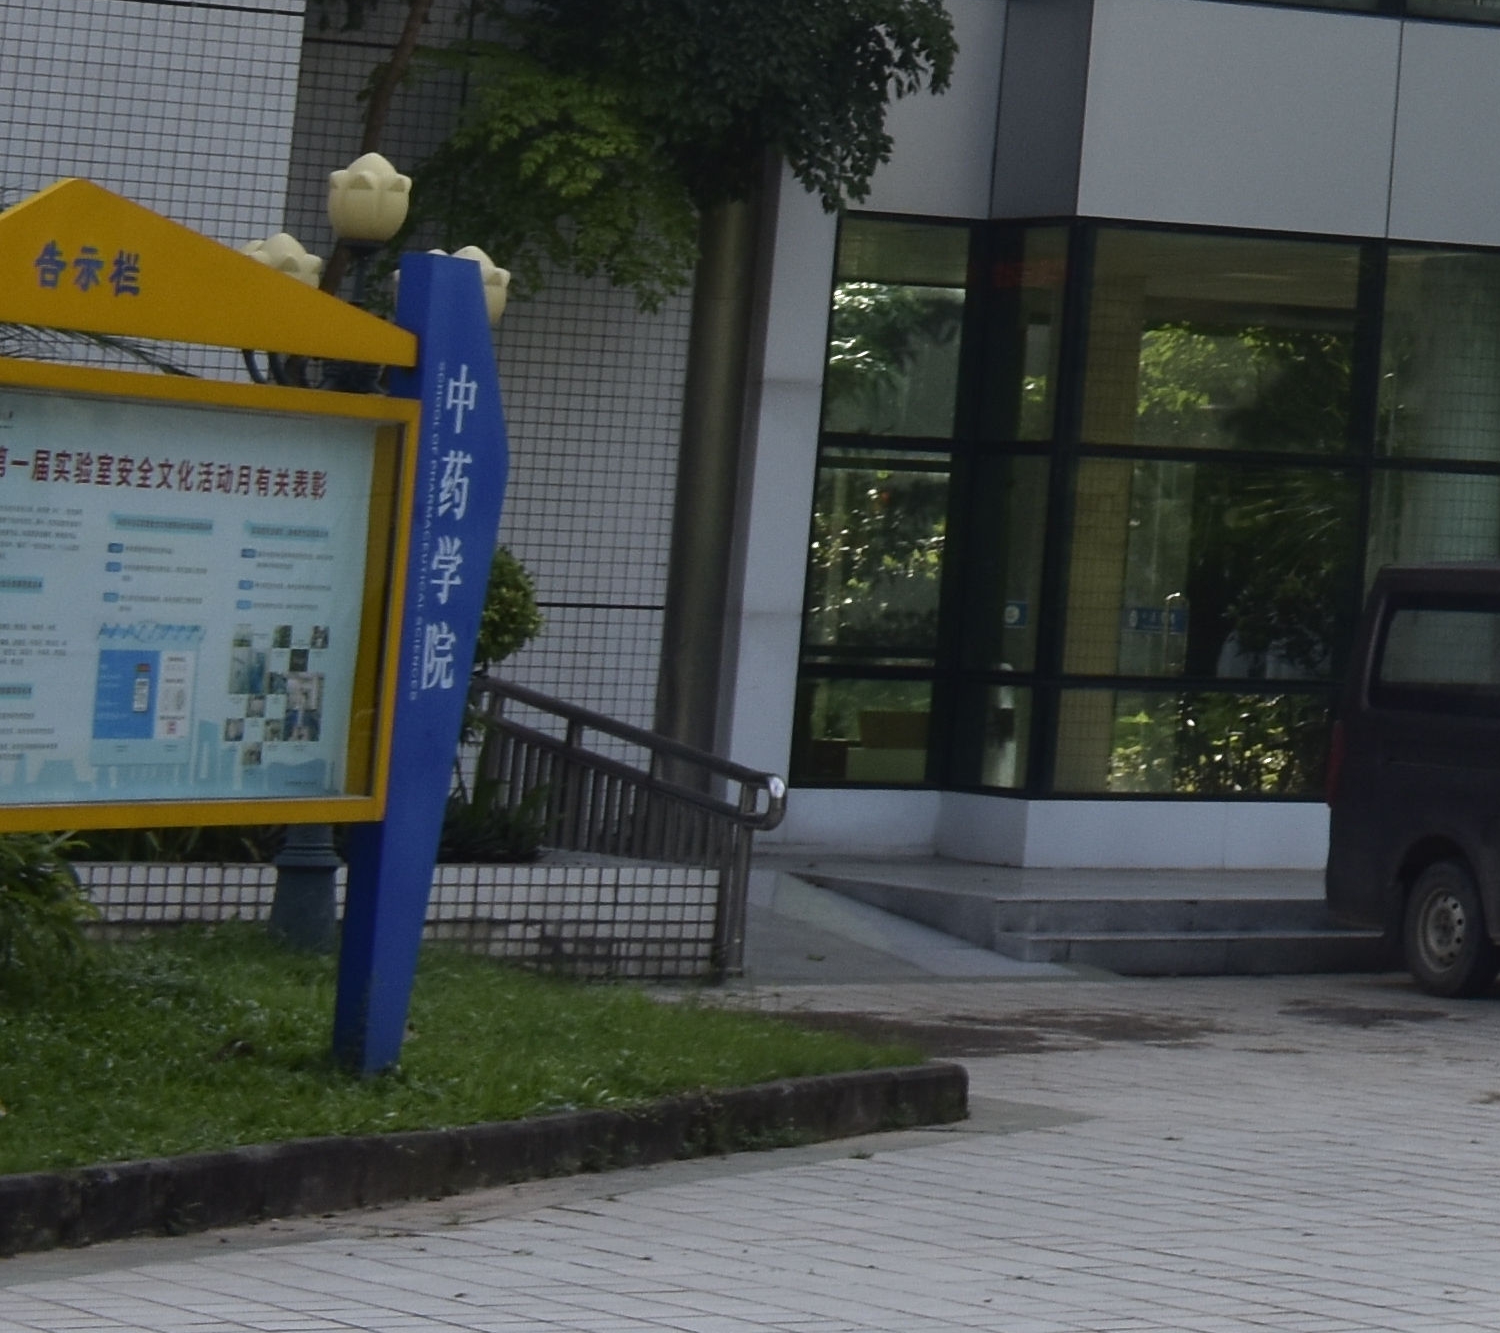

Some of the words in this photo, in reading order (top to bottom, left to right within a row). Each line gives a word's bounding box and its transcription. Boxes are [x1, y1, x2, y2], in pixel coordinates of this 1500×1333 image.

[34, 239, 140, 297] 告示栏
[420, 363, 479, 690] 中药学院
